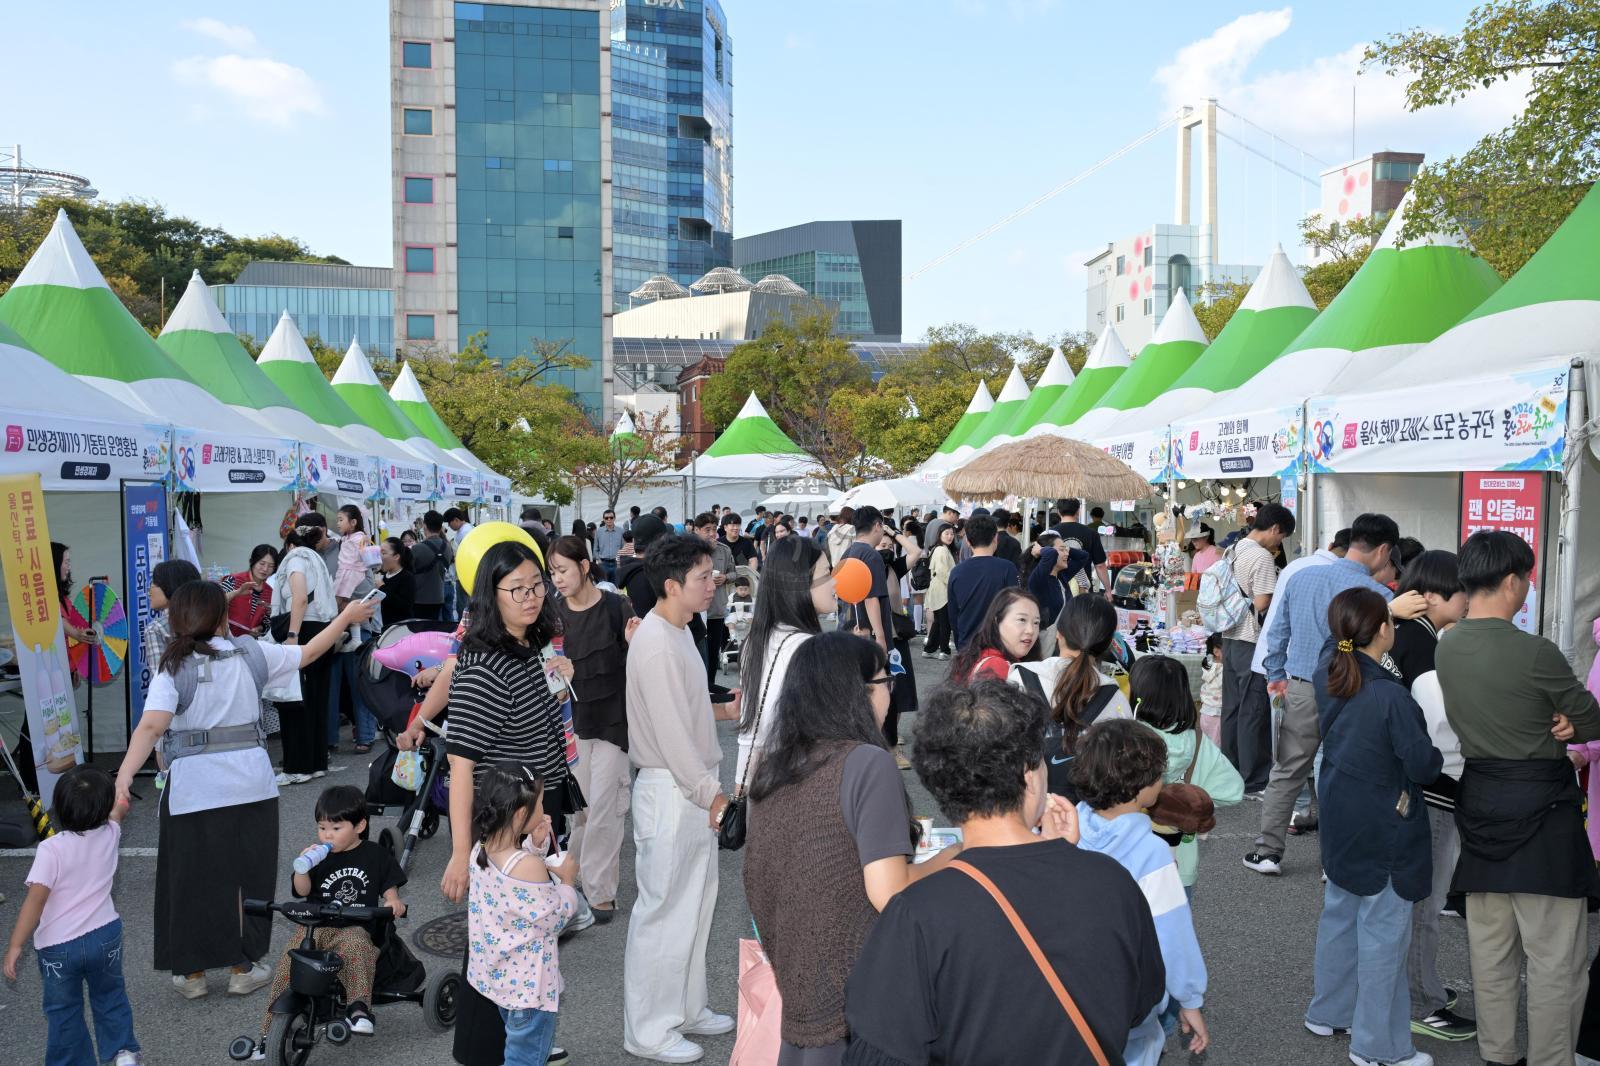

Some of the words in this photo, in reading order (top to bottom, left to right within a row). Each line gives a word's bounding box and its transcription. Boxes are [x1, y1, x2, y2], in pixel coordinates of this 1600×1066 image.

[1512, 402, 1534, 416] 2026
[1360, 420, 1378, 446] 울산
[1433, 412, 1455, 440] 프로
[1458, 409, 1495, 441] 농구단
[27, 429, 80, 454] 민생경제119
[81, 433, 106, 456] 기동팀
[107, 435, 139, 458] 운영홍보
[20, 491, 37, 541] 무료
[1468, 499, 1482, 521] 팬
[1487, 499, 1535, 522] 인증하고
[320, 867, 370, 890] BASKETBALL
